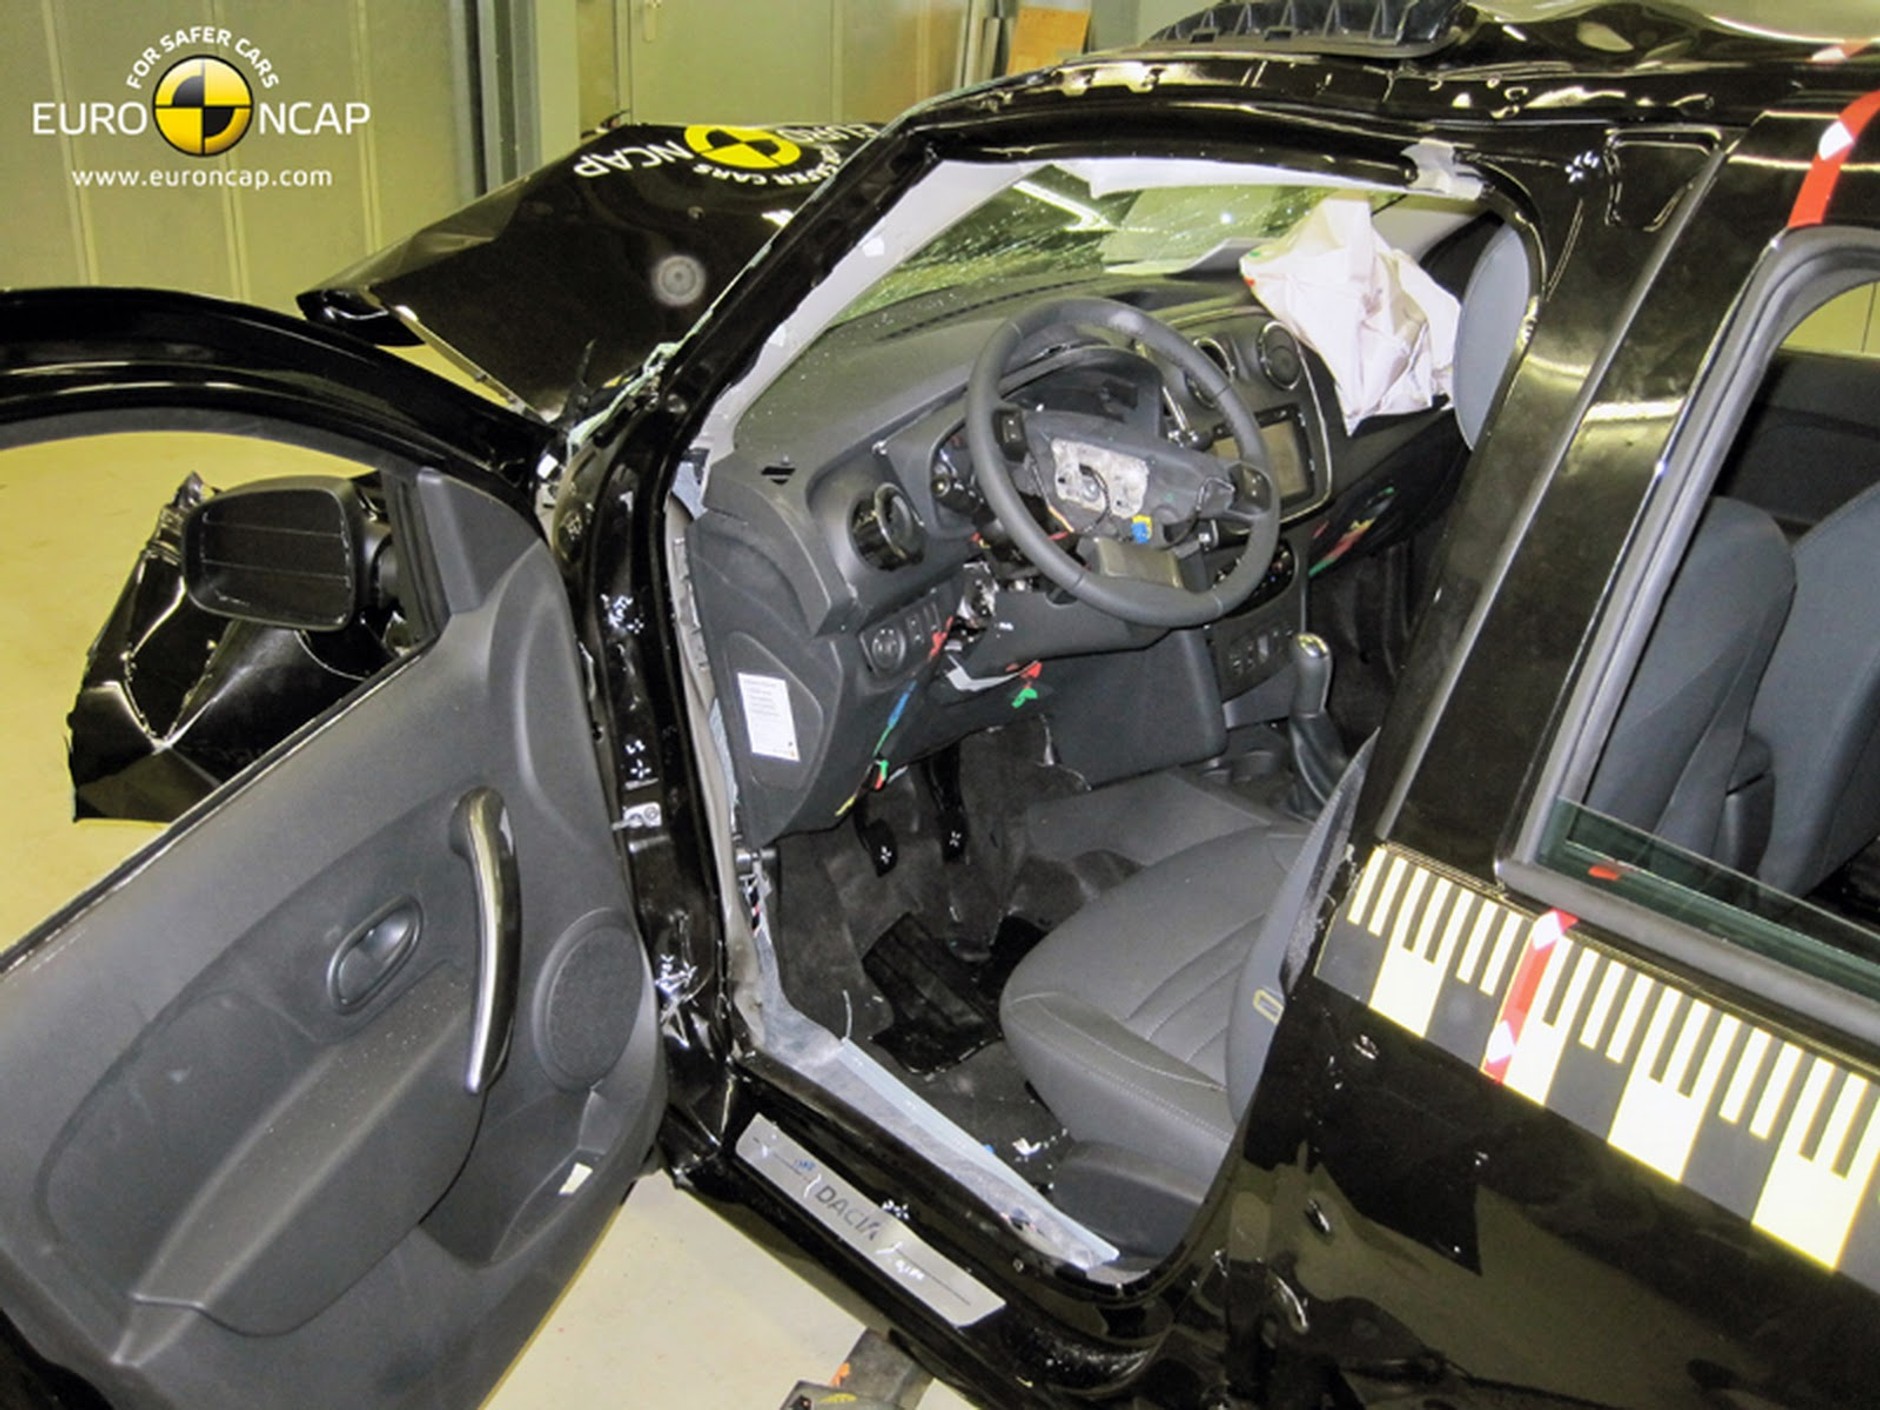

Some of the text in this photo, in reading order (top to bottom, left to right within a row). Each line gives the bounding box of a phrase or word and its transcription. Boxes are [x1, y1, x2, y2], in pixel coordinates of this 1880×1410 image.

[573, 140, 694, 178] NCAP
[692, 163, 767, 186] CARS
[814, 1185, 883, 1242] DACIA
